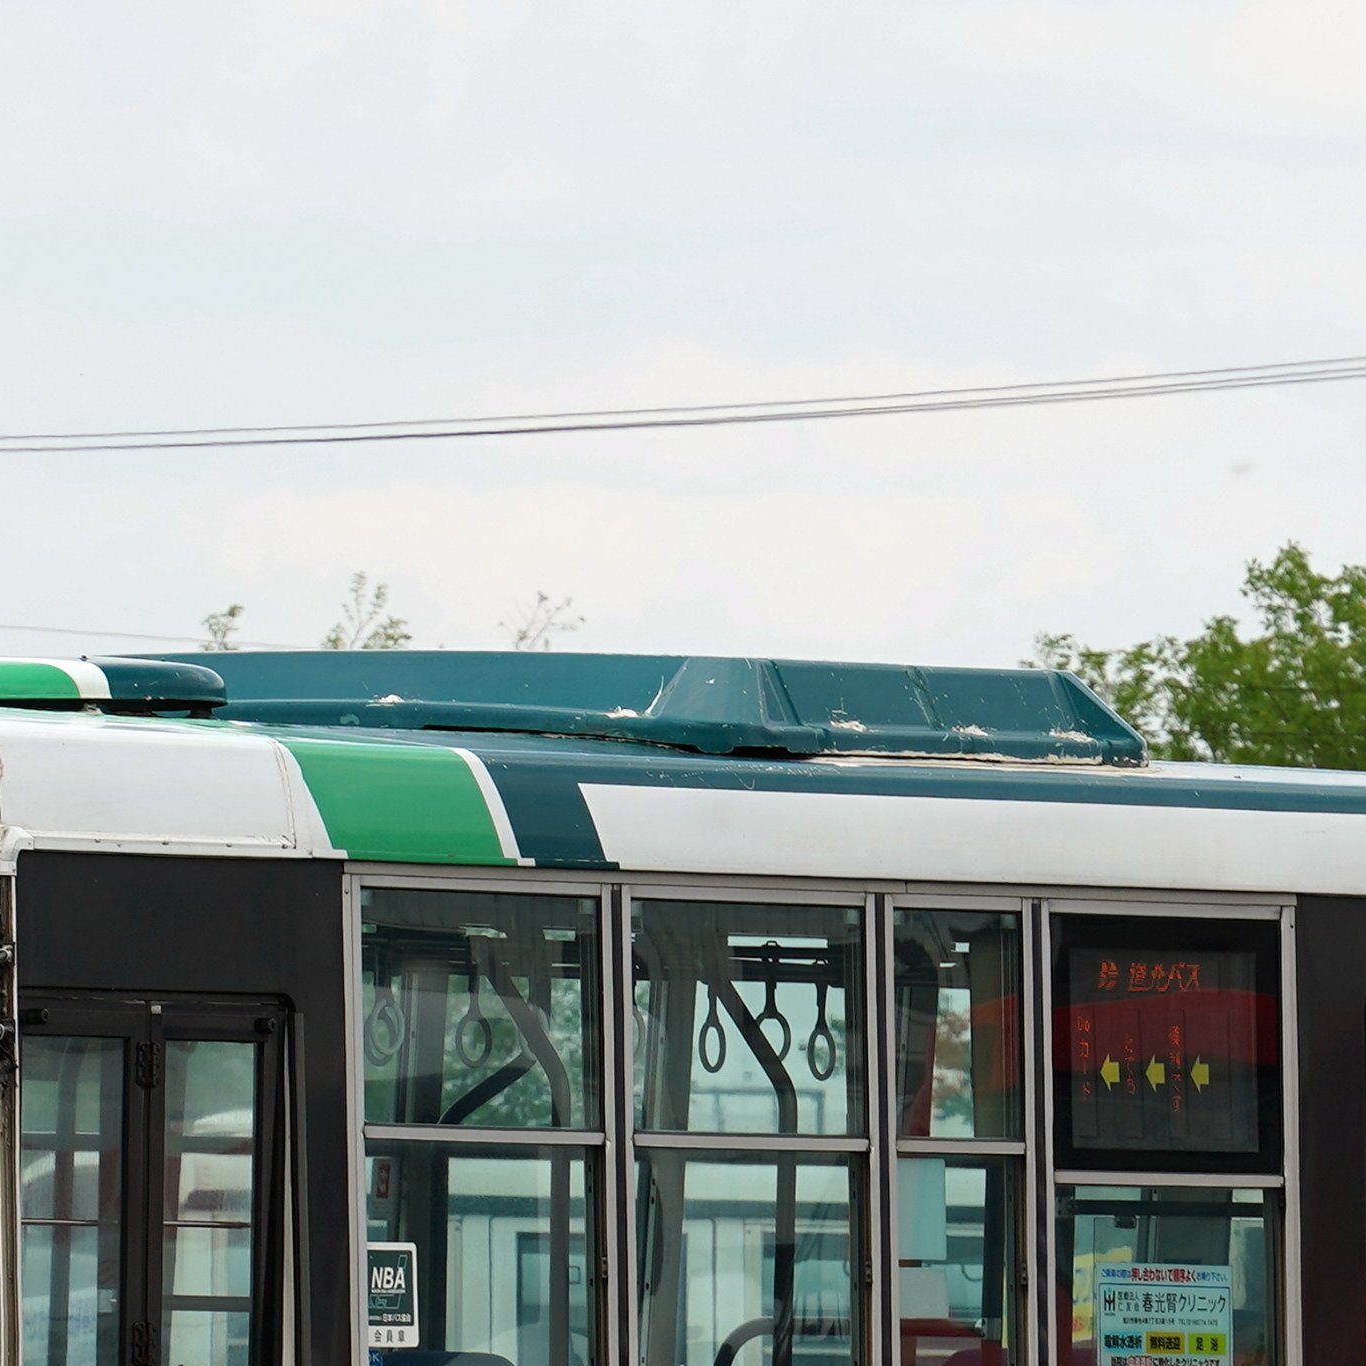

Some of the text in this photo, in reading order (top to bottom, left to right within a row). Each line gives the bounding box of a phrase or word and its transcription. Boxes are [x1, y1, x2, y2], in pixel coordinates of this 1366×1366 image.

[371, 1266, 406, 1289] NBA
[1142, 1291, 1226, 1314] 春光腎クリニック
